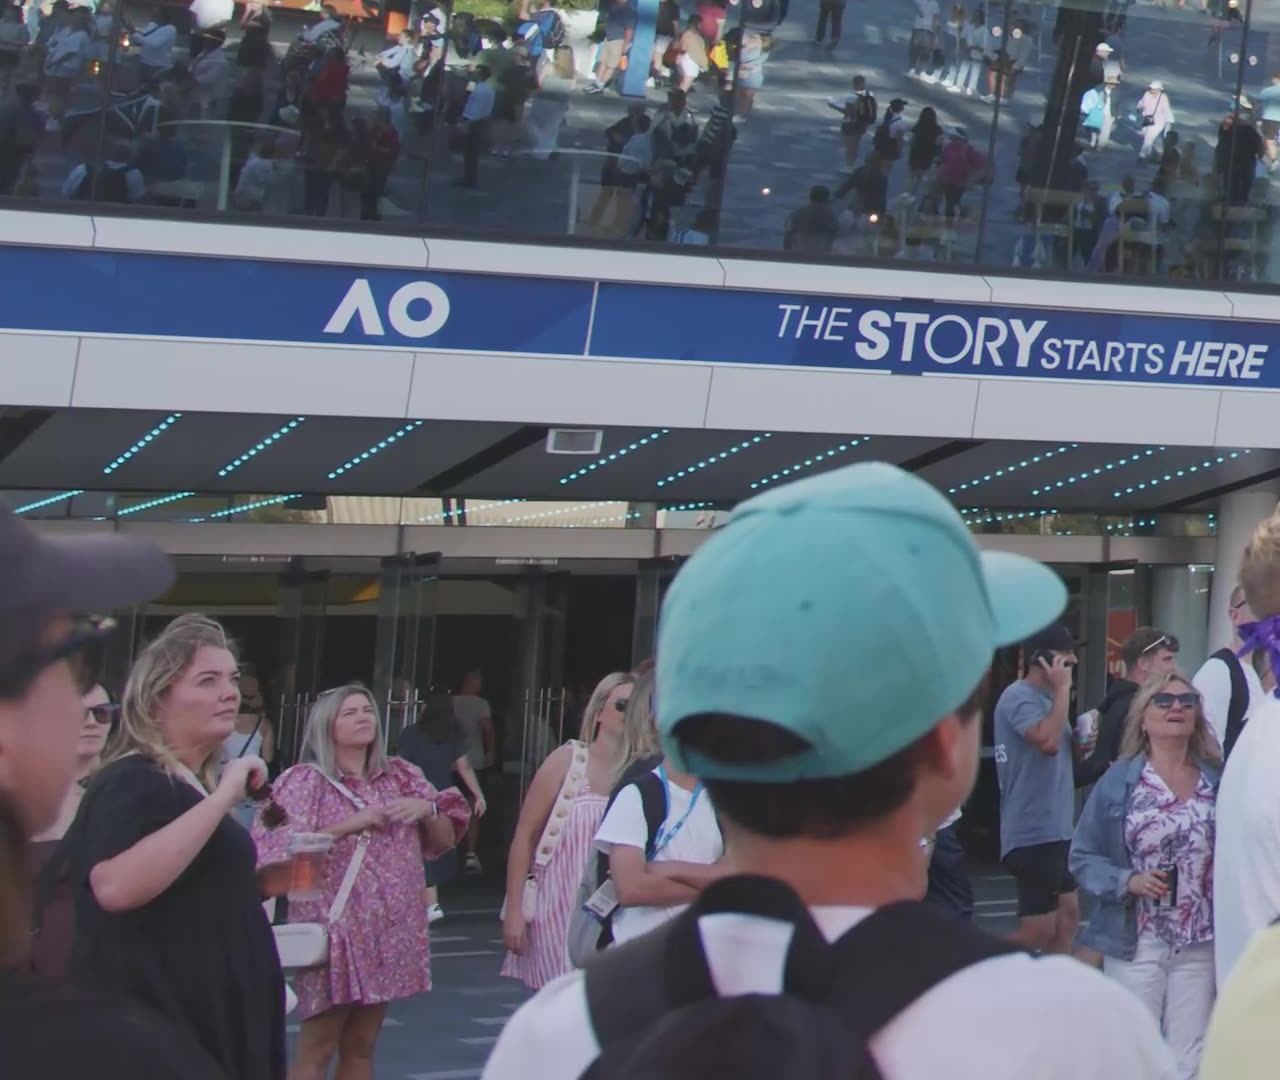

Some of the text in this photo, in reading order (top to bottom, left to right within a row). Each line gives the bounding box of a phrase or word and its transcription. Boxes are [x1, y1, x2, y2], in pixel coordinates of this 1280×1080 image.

[323, 278, 450, 338] AO
[777, 304, 1268, 380] THE STORY STARTS HERE
